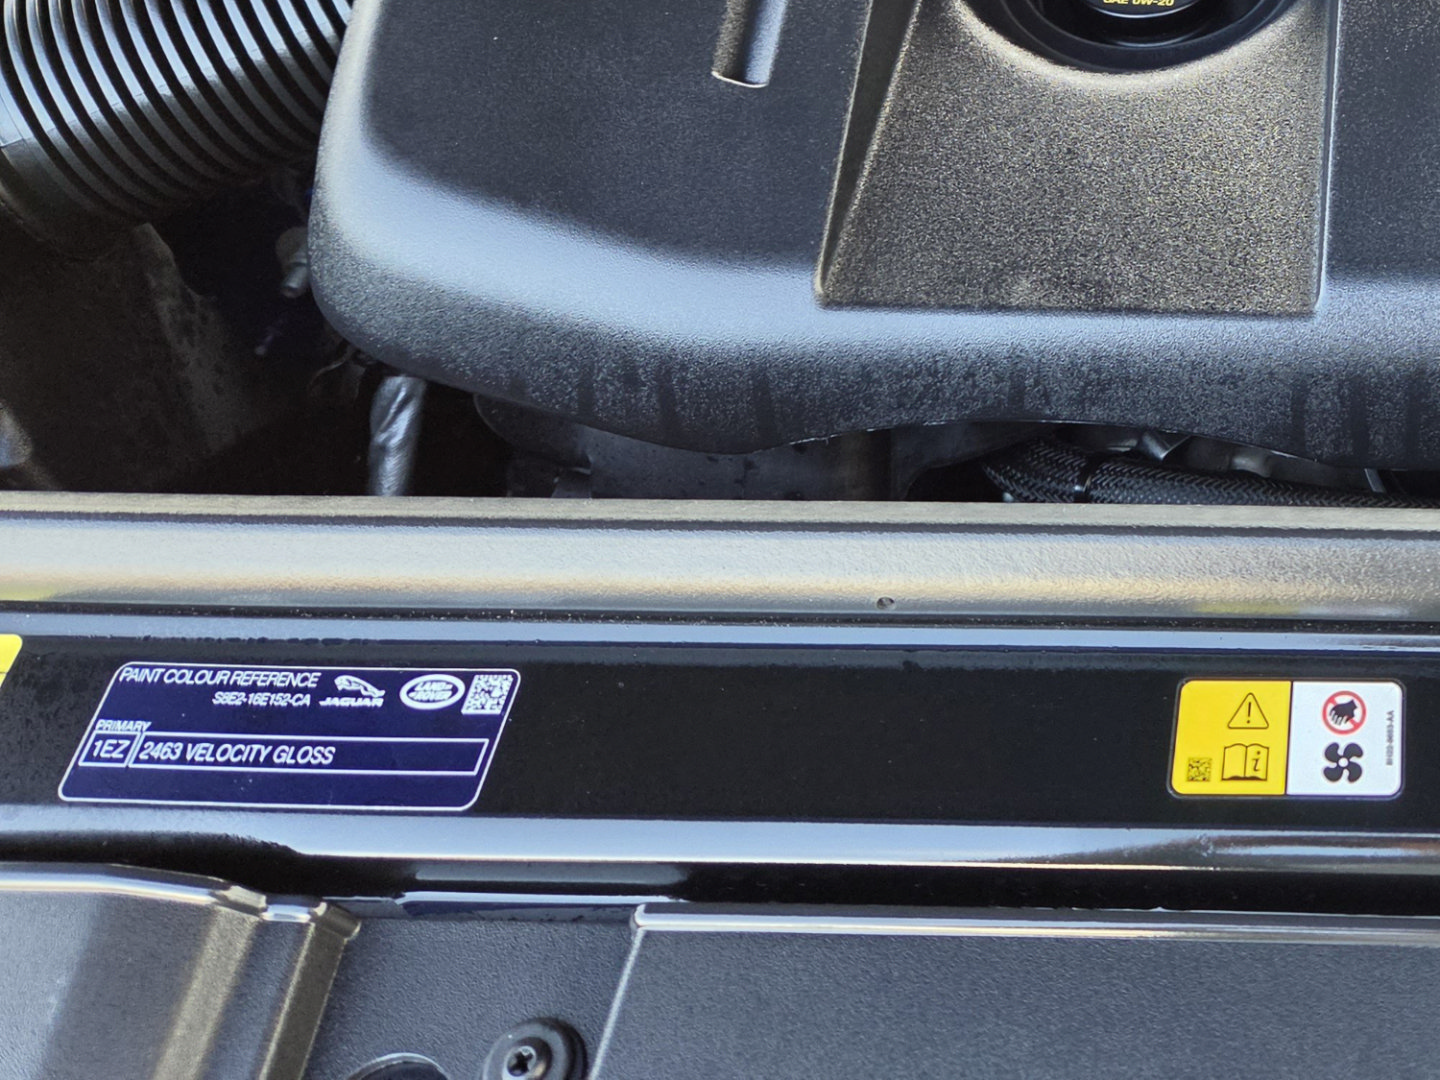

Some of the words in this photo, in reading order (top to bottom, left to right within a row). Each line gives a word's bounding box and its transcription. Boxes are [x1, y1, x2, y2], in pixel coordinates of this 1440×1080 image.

[119, 667, 165, 683] PAINT
[163, 669, 231, 685] COLOUR
[230, 671, 321, 687] REFERENCE
[319, 697, 384, 707] JAGUAR
[95, 719, 151, 732] PRIMARY
[93, 740, 131, 759] 1EZ
[139, 742, 182, 760] 2463
[185, 743, 271, 763] VELOCITY
[271, 746, 336, 765] GLOSS
